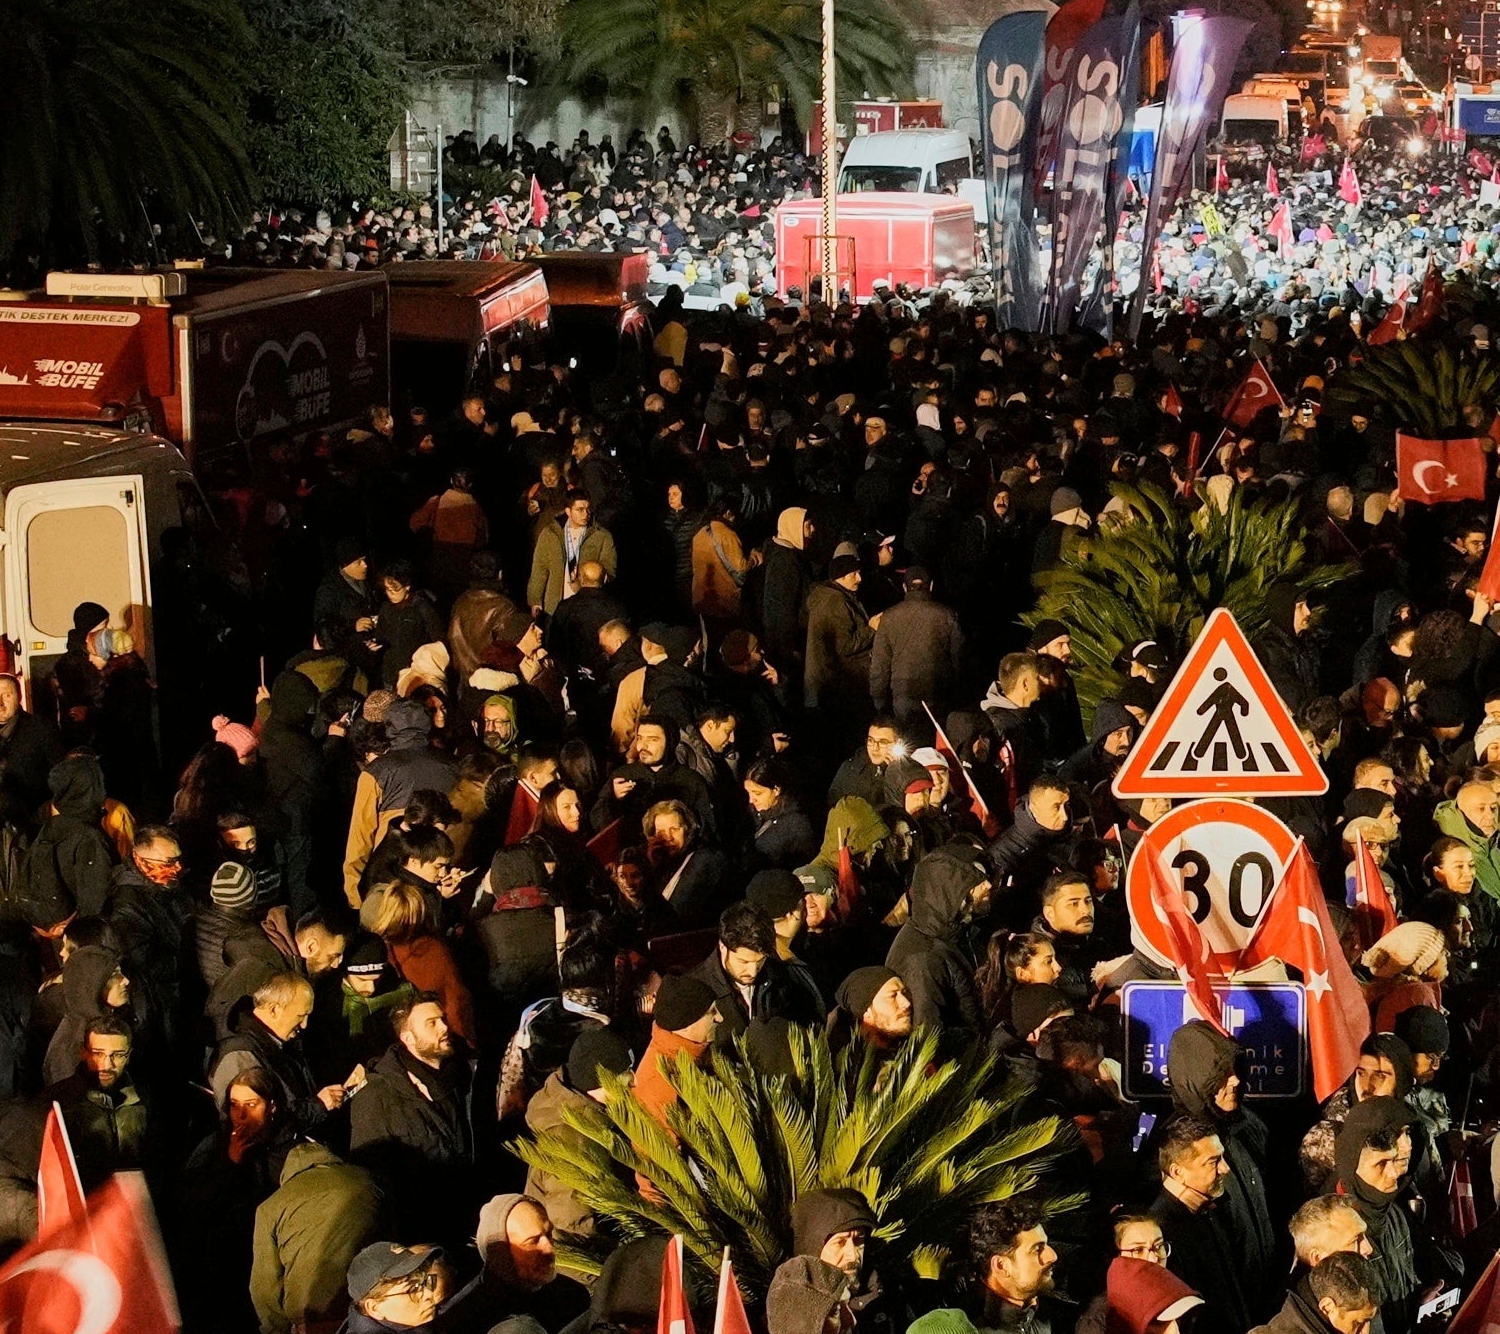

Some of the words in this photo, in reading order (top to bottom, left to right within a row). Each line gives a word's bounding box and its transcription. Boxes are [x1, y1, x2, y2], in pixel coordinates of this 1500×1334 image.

[20, 311, 71, 322] DESTEK
[72, 313, 129, 323] MERKEZİ
[1171, 849, 1274, 929] 30
